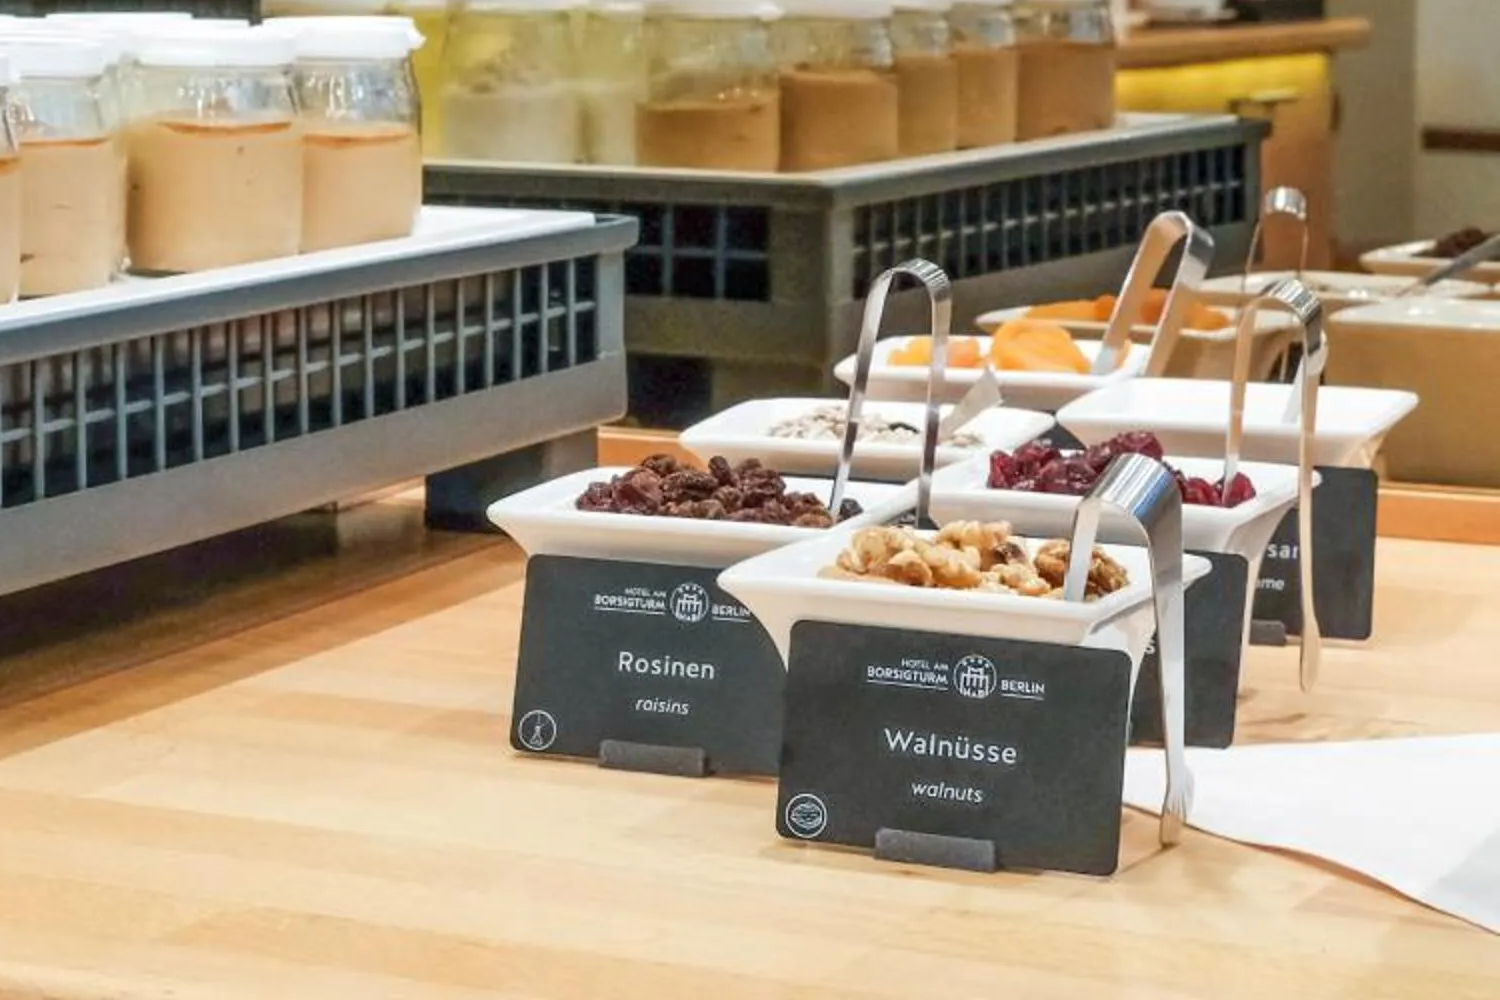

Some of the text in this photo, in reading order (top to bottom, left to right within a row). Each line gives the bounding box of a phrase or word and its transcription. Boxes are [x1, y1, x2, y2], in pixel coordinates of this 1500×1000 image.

[625, 587, 651, 597] HOTEL
[595, 594, 750, 617] BORSIGTURM BERLIN
[618, 650, 716, 680] Rosinen
[902, 658, 949, 671] HOTEL AM
[867, 666, 1045, 694] BORSIGTURM BERLIN
[636, 698, 690, 716] raisins
[884, 727, 1018, 765] Walnüsse
[911, 781, 984, 804] walnuts
